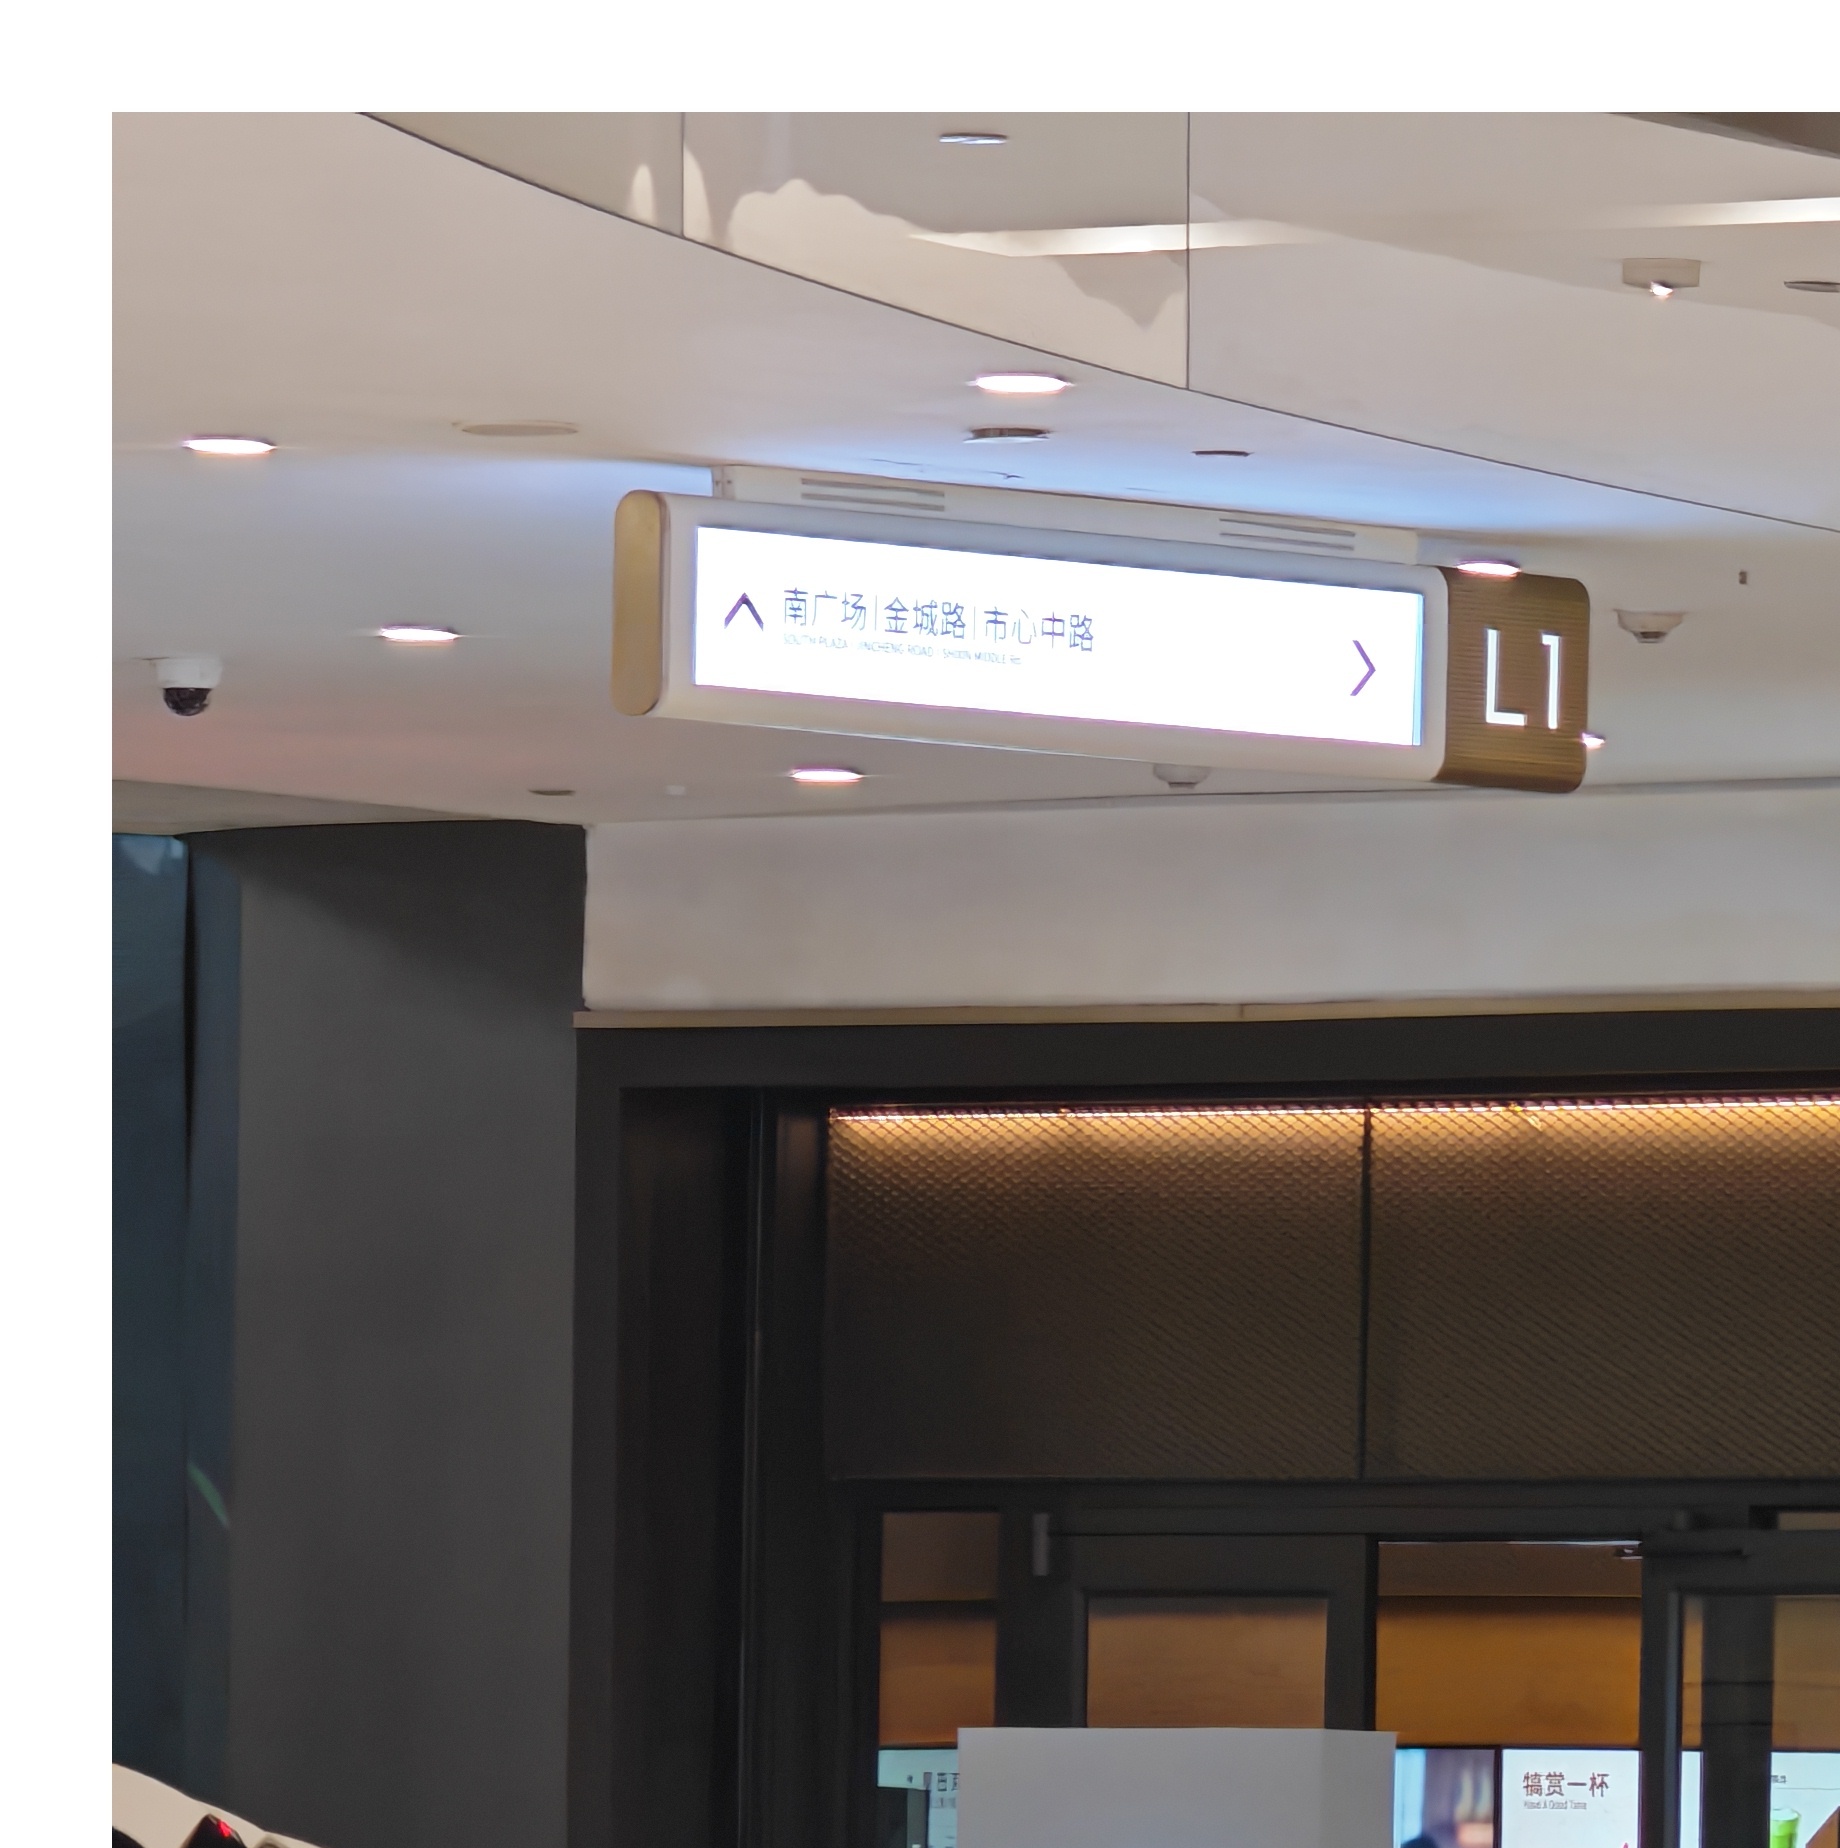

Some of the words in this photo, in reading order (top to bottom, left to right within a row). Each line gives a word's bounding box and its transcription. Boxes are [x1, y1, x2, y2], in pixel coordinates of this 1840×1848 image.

[784, 587, 867, 631] 南广场
[884, 597, 966, 639] 金城路
[983, 607, 1094, 652] 市心中路
[1485, 629, 1560, 731] L1
[1523, 1772, 1610, 1798] 犒赏一杯
